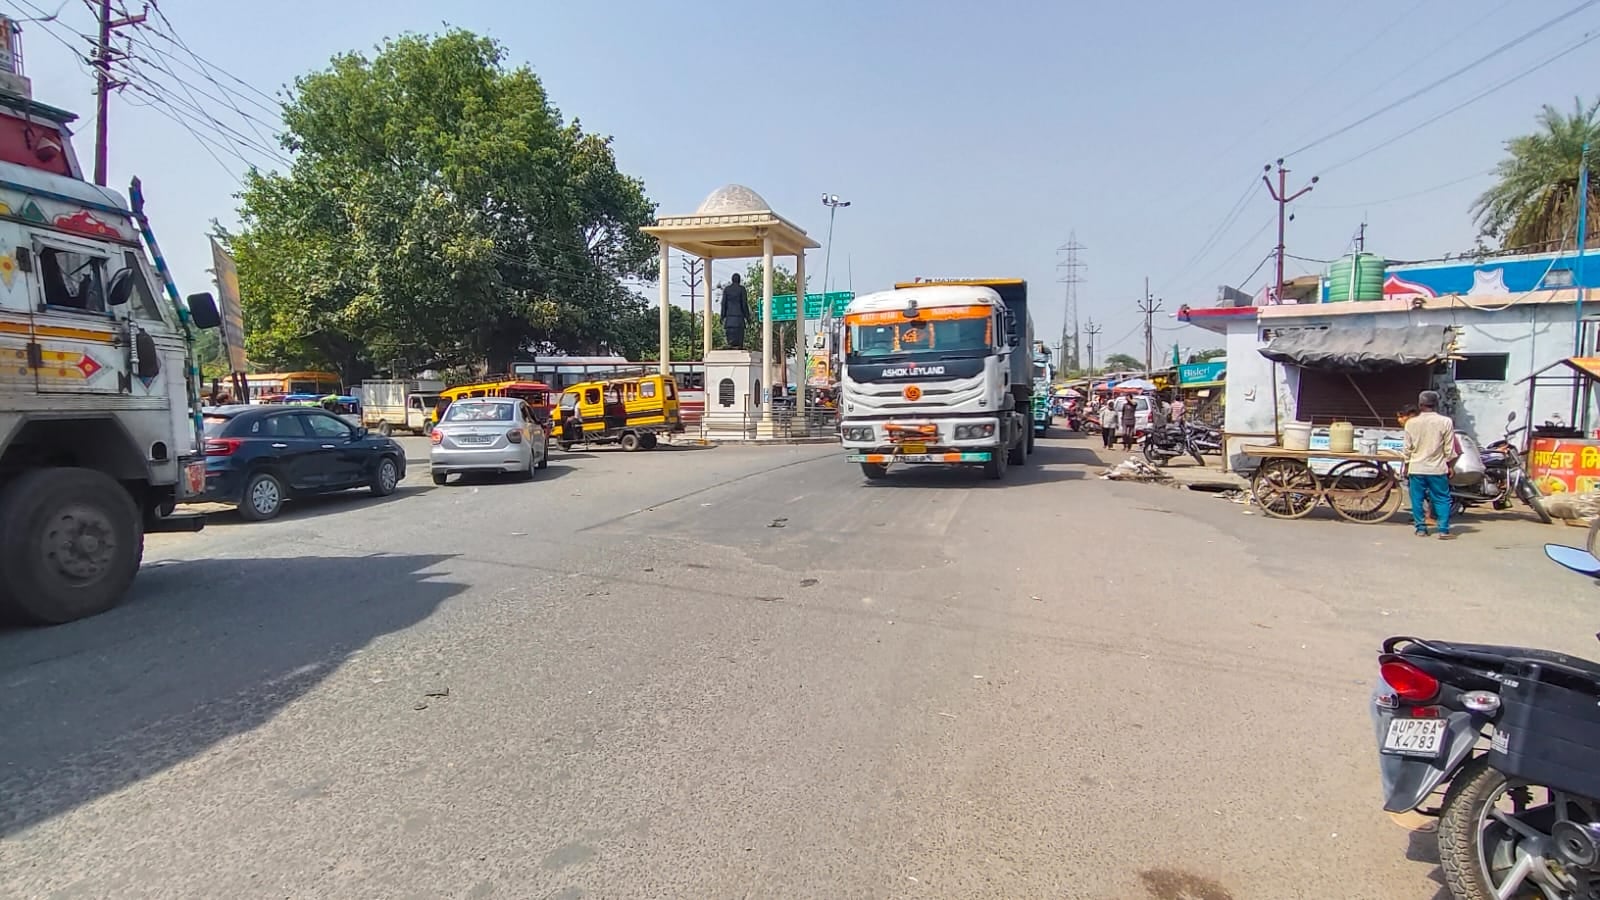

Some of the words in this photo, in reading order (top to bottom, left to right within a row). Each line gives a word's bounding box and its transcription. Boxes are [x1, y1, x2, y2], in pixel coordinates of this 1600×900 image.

[882, 368, 909, 378] ASHOK
[909, 366, 945, 376] LEYLAND
[1184, 367, 1210, 377] Bisleri
[1398, 720, 1437, 735] UP76A
[1395, 734, 1435, 749] K4783
